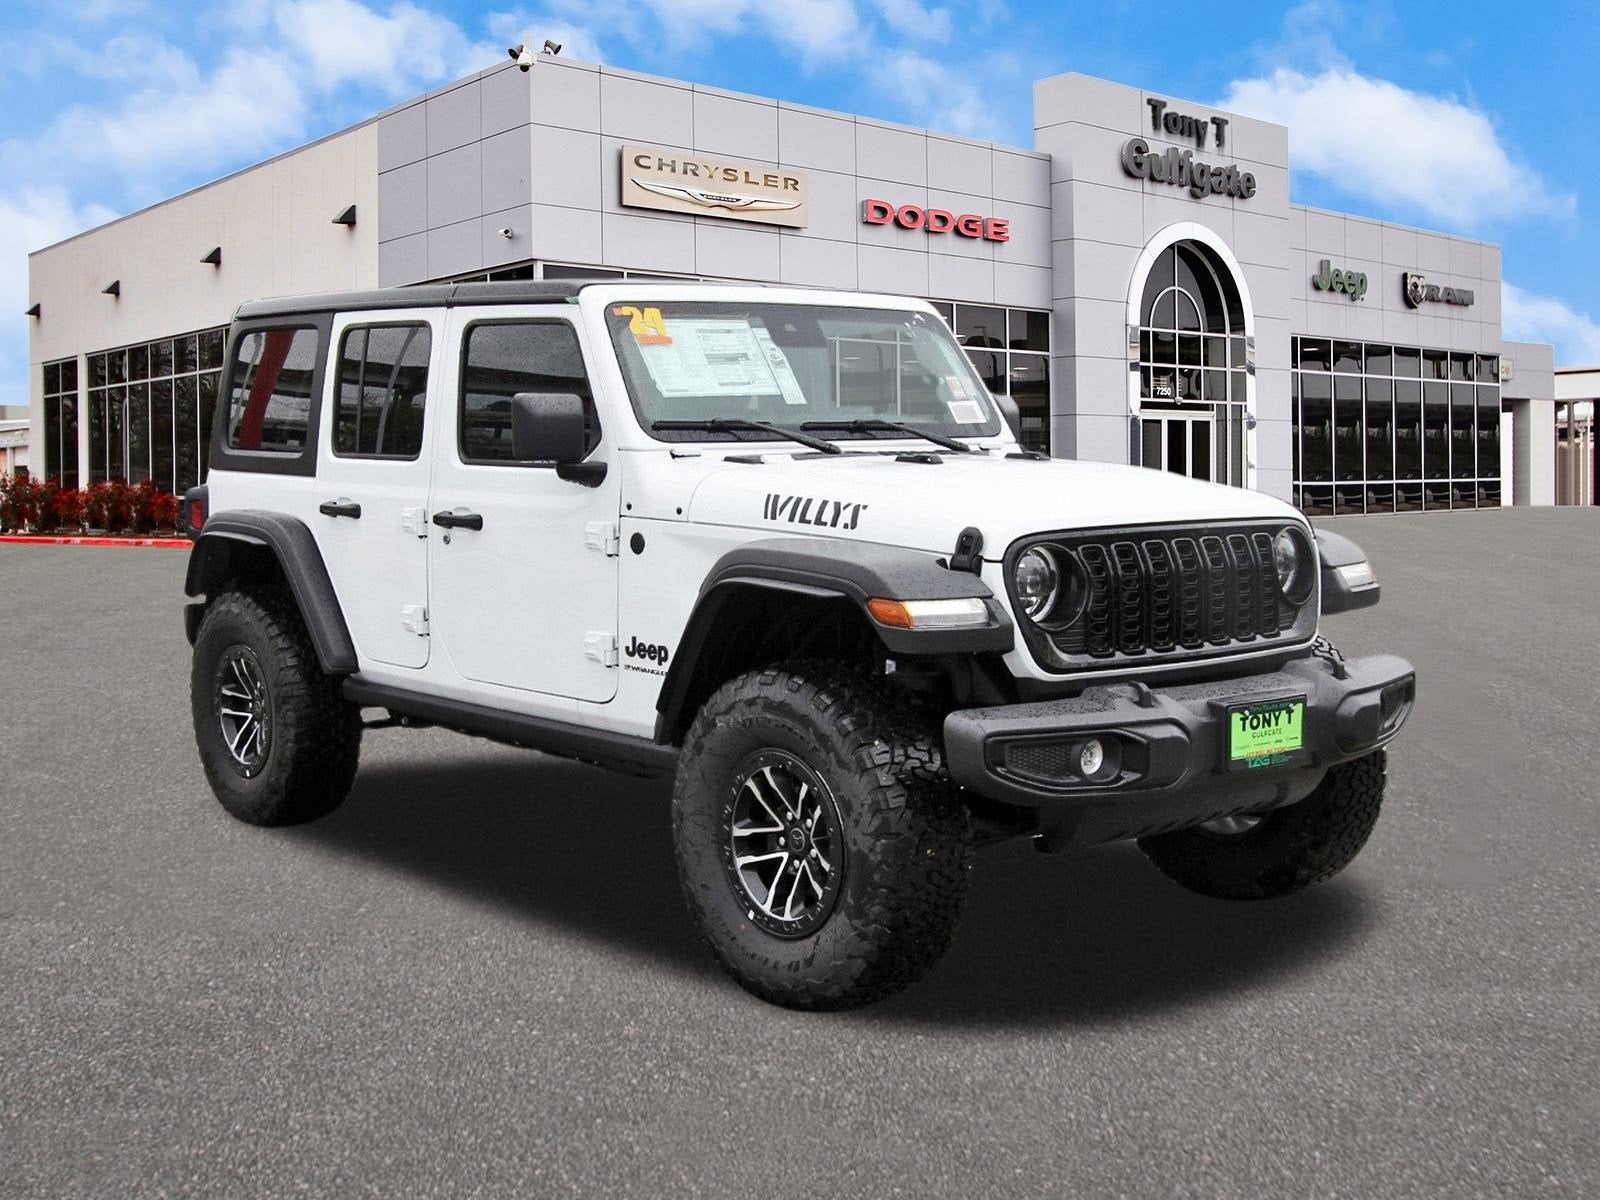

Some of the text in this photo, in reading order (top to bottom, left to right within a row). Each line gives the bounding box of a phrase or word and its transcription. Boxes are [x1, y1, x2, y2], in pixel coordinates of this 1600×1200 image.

[1146, 98, 1229, 147] Tony T
[633, 154, 800, 191] CHRYSLER
[1121, 138, 1257, 199] Gulfgate
[862, 199, 1010, 242] DODGE
[1312, 259, 1368, 302] Jeep
[1425, 284, 1475, 307] RAM
[1156, 386, 1172, 396] 7250
[763, 493, 869, 530] WILLYS
[625, 636, 669, 666] Jeep
[1240, 708, 1294, 732] TONY T
